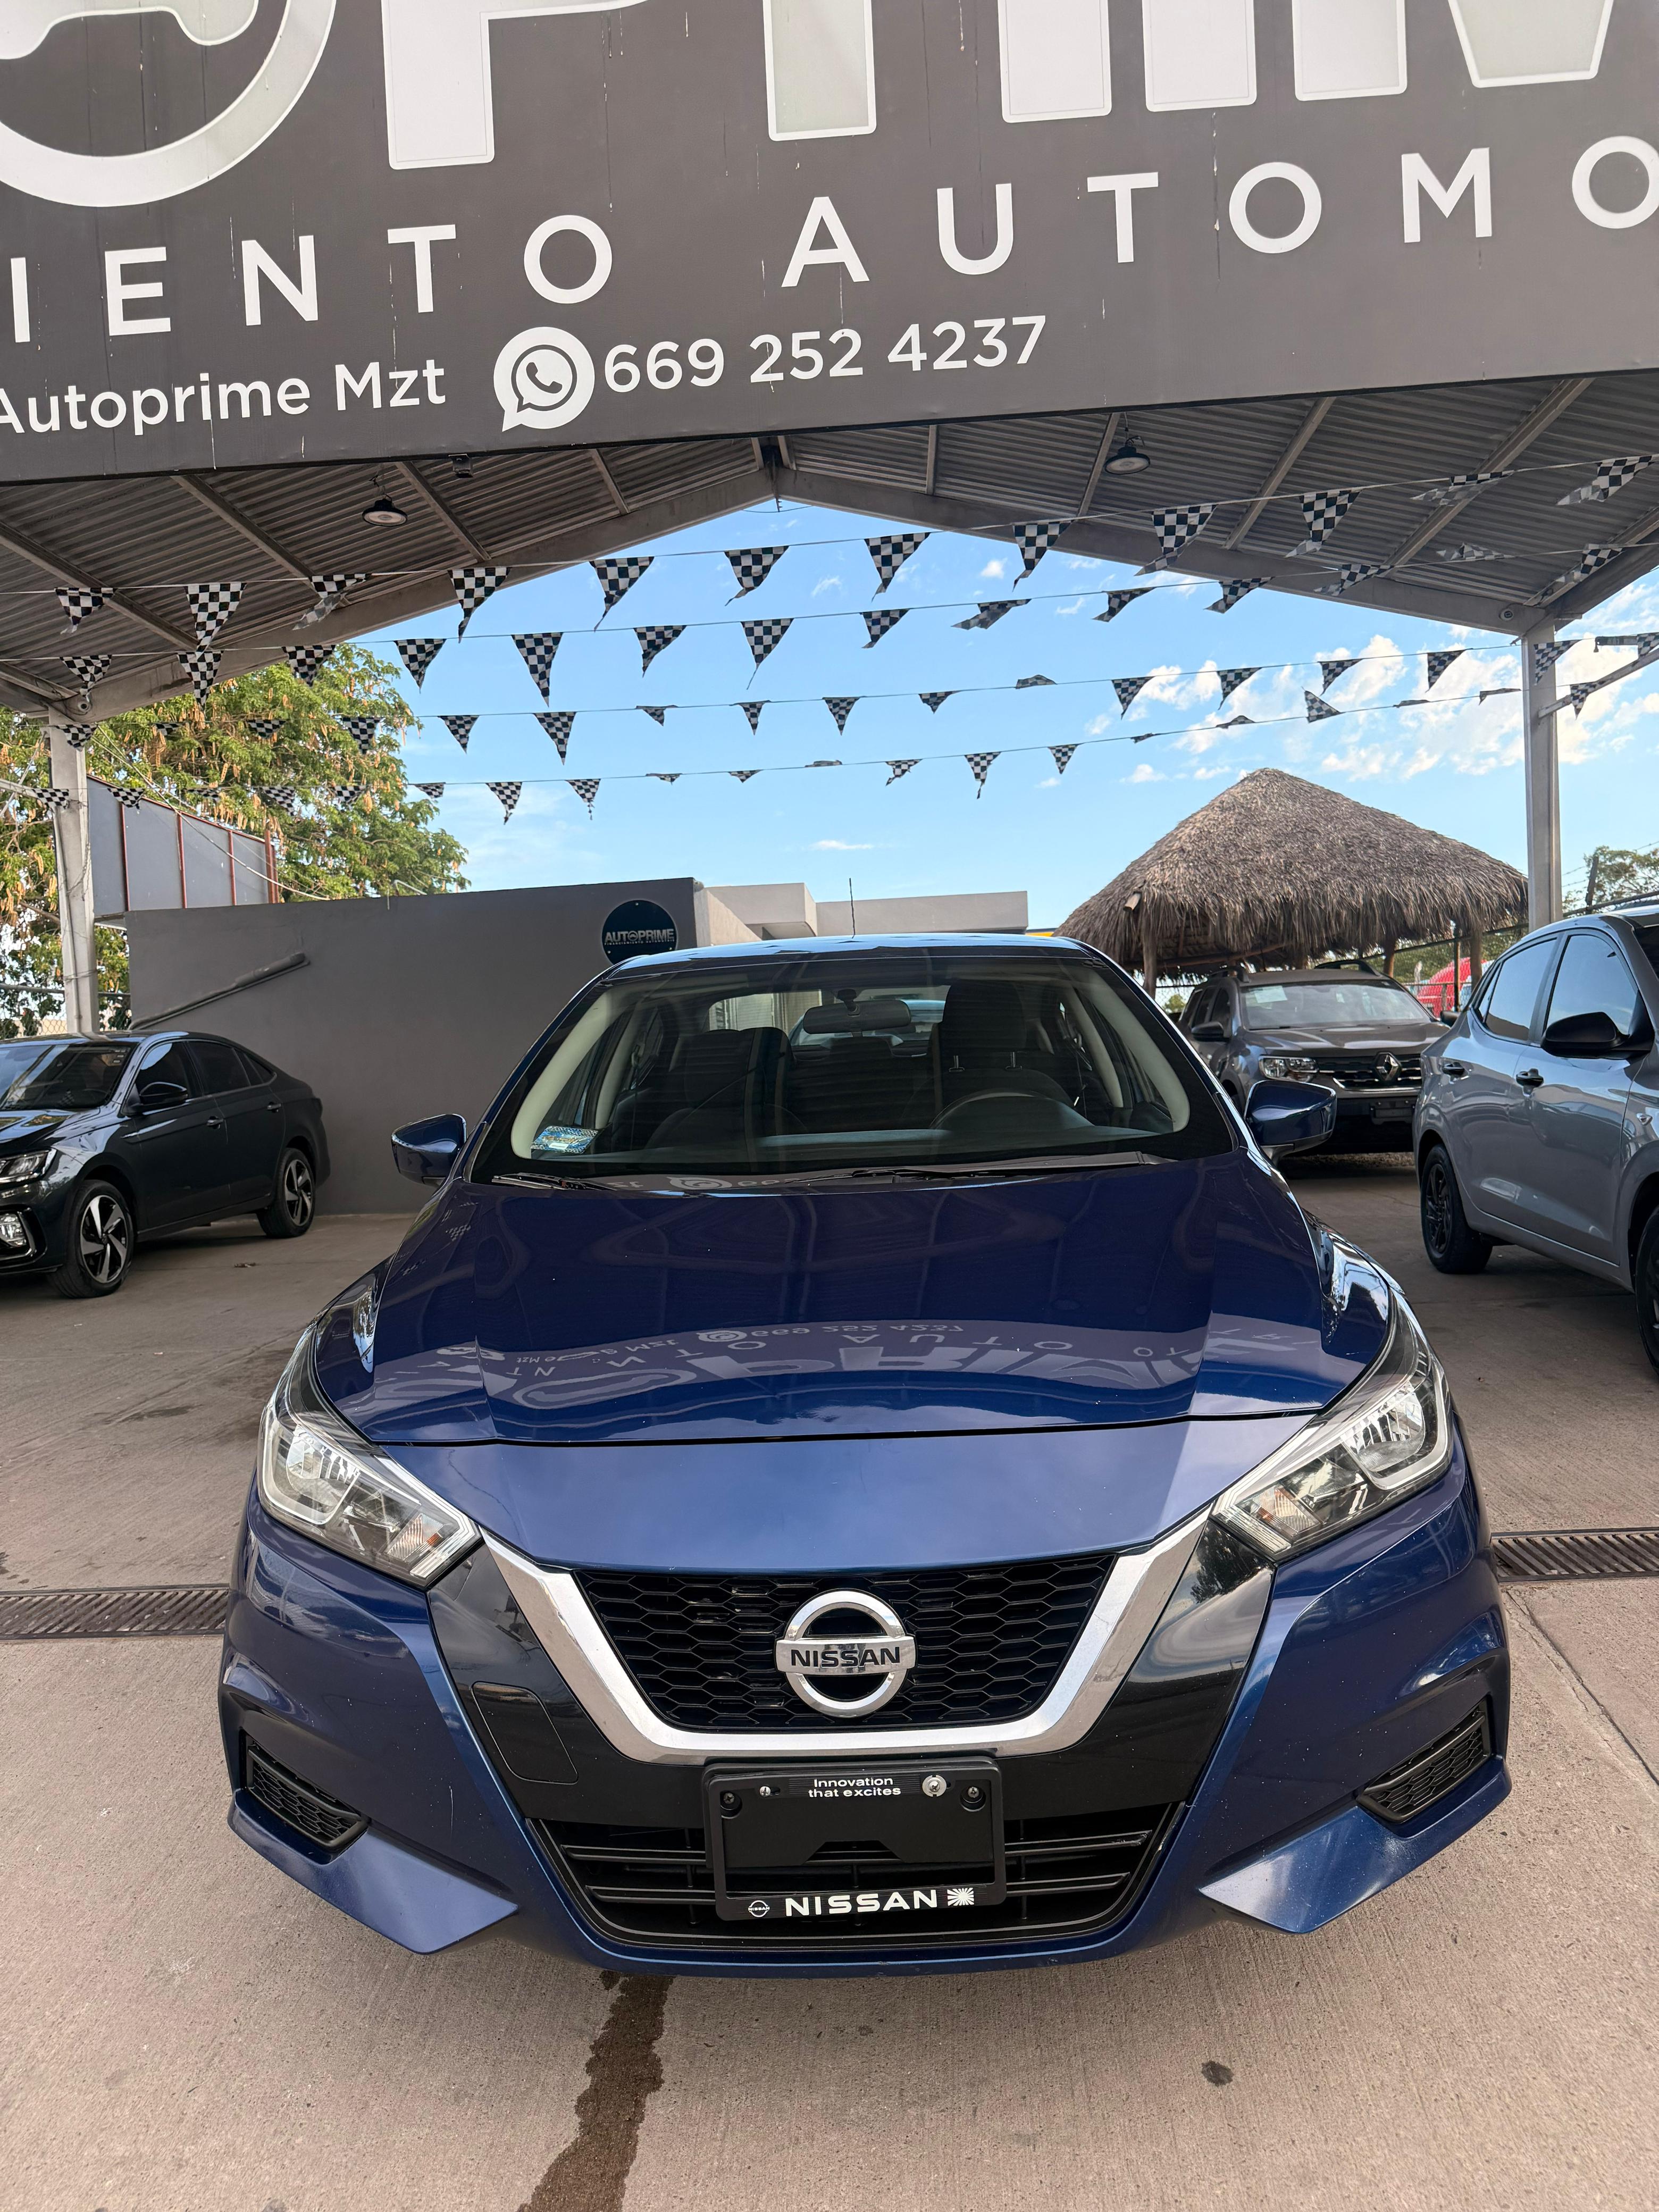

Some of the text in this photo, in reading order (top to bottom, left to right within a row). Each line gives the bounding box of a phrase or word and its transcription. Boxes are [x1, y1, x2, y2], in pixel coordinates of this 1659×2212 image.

[604, 315, 1046, 393] 669 252 4237
[335, 359, 446, 410] Mzt
[605, 928, 675, 943] AUTOPRIME
[791, 1646, 901, 1668] NISSAN
[808, 1787, 902, 1798] that excites
[814, 1777, 893, 1788] Innovation
[785, 1889, 938, 1916] NISSAN
